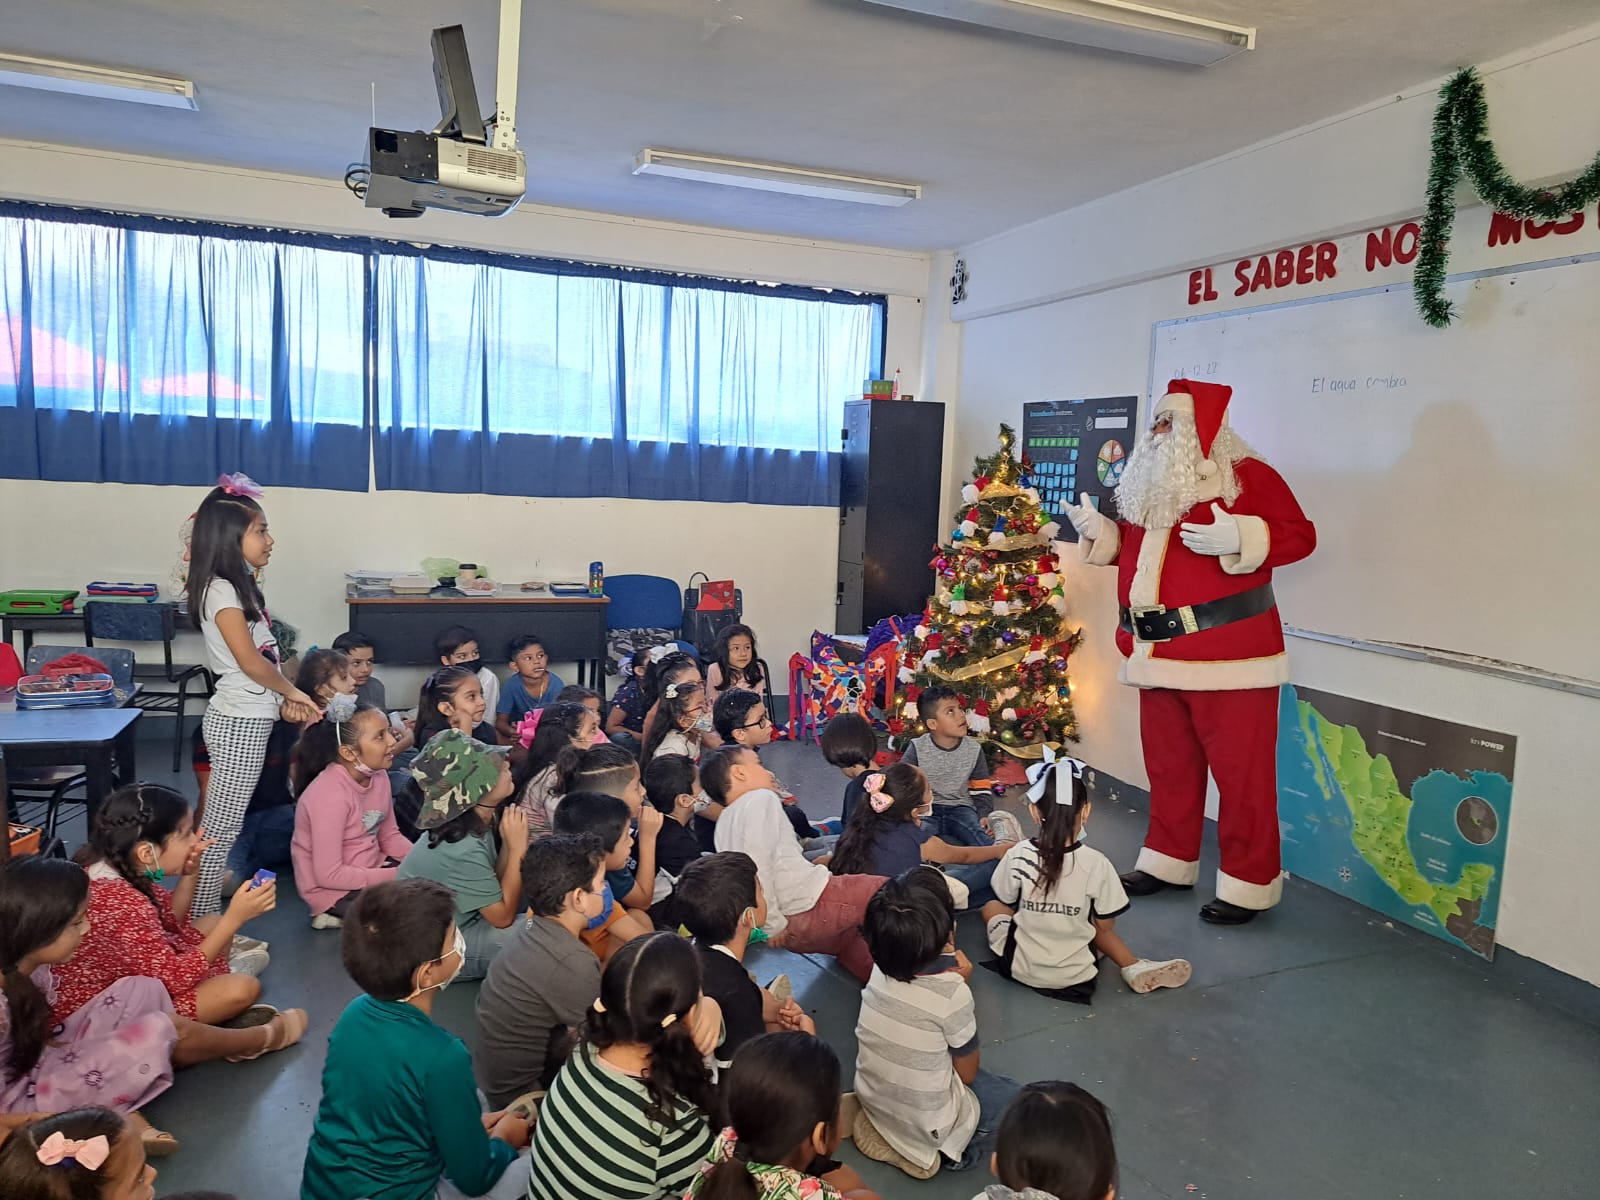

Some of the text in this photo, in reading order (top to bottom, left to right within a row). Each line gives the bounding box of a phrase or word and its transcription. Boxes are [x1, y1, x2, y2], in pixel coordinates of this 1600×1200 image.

[1188, 267, 1218, 305] EL
[1234, 241, 1338, 297] SABER
[1365, 222, 1423, 272] NO
[1311, 376, 1325, 394] El
[1330, 379, 1356, 395] agua
